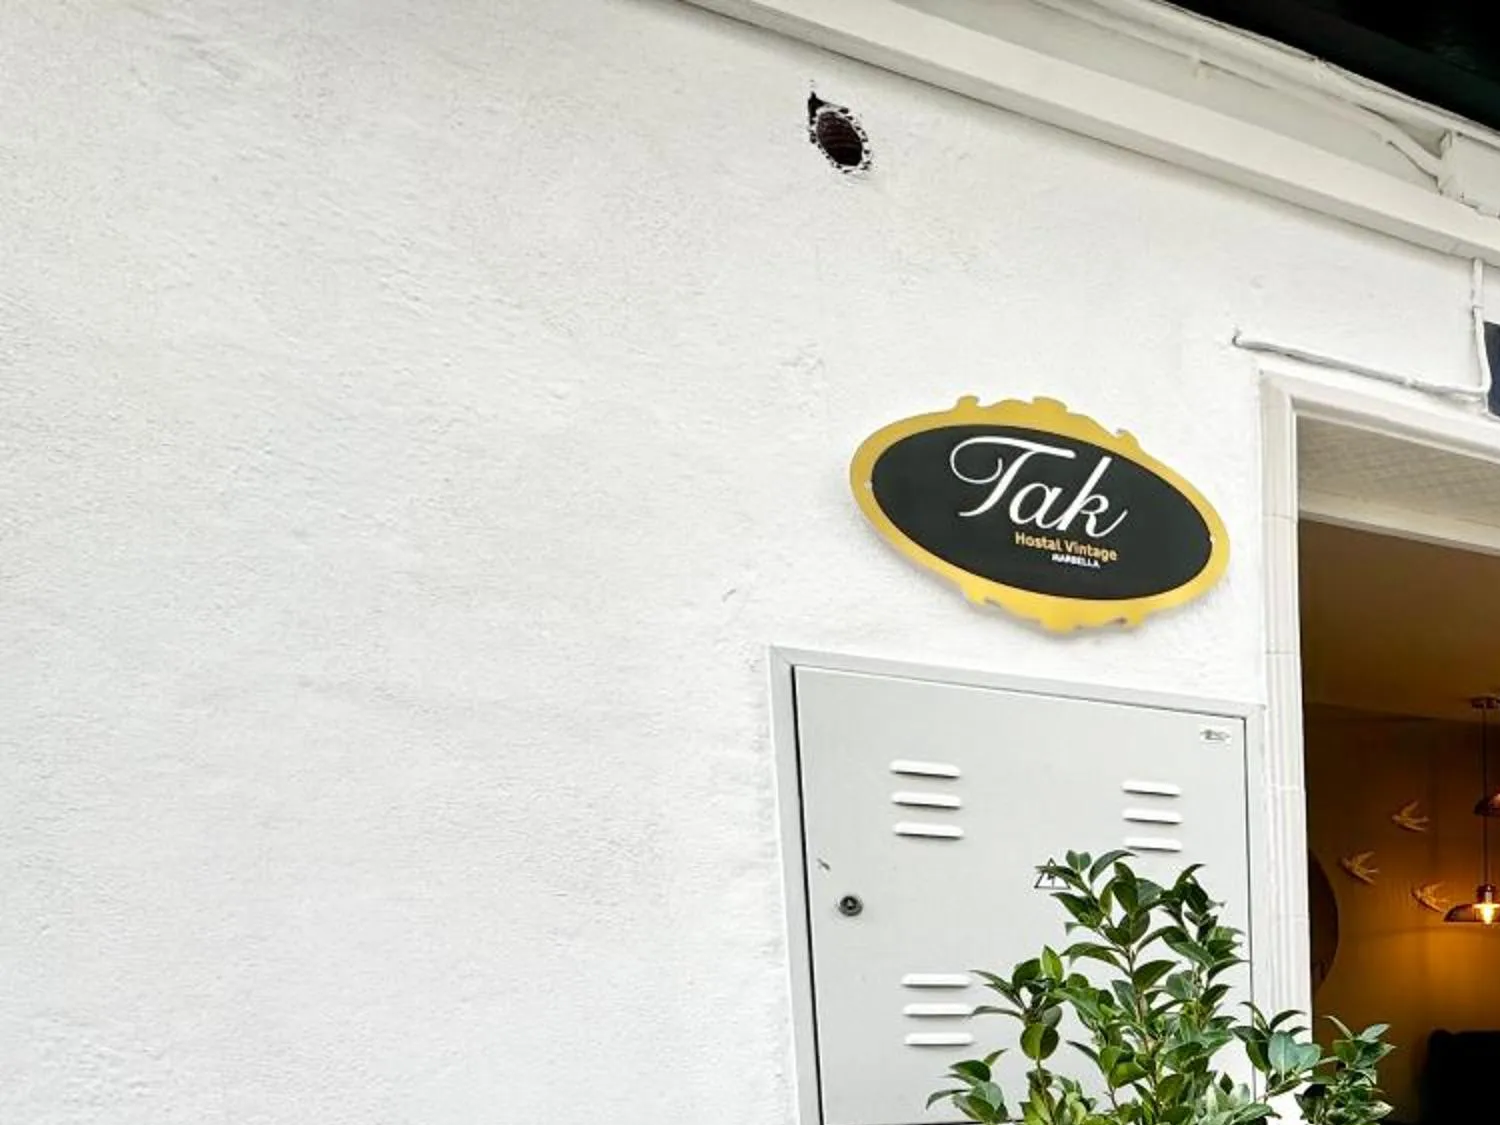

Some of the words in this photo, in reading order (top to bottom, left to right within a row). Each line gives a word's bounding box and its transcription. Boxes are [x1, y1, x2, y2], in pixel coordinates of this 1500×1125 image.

[950, 435, 1129, 538] Tak
[1015, 531, 1062, 553] Hostal
[1063, 540, 1118, 562] Vintage
[1051, 553, 1101, 568] MARBELLA
